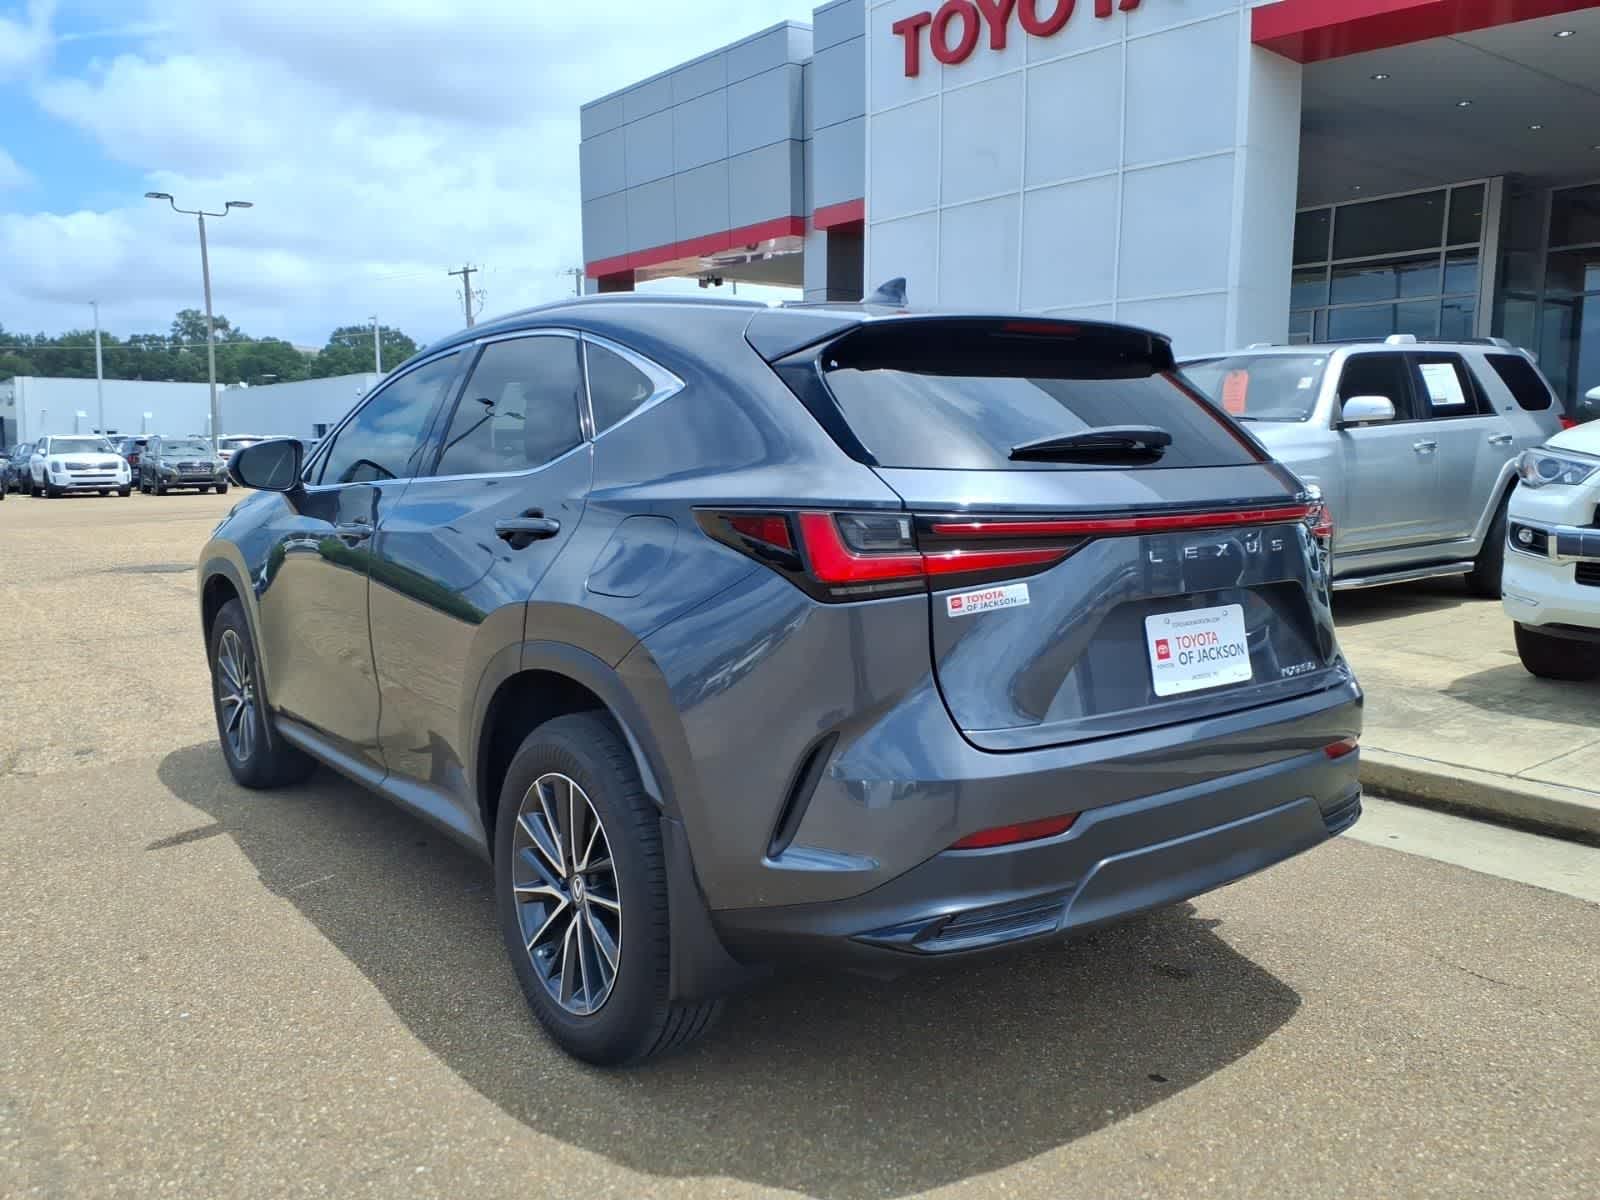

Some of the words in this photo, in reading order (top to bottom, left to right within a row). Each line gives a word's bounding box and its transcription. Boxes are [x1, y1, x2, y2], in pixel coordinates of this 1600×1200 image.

[893, 0, 1141, 77] TOYO
[1149, 538, 1284, 563] LEXUS
[967, 591, 1004, 603] TOYOTA
[967, 604, 977, 612] OF
[981, 597, 1016, 609] JACKSON
[1176, 631, 1219, 650] TOYOTA
[1178, 650, 1194, 666] OF
[1197, 643, 1245, 663] JACKSON
